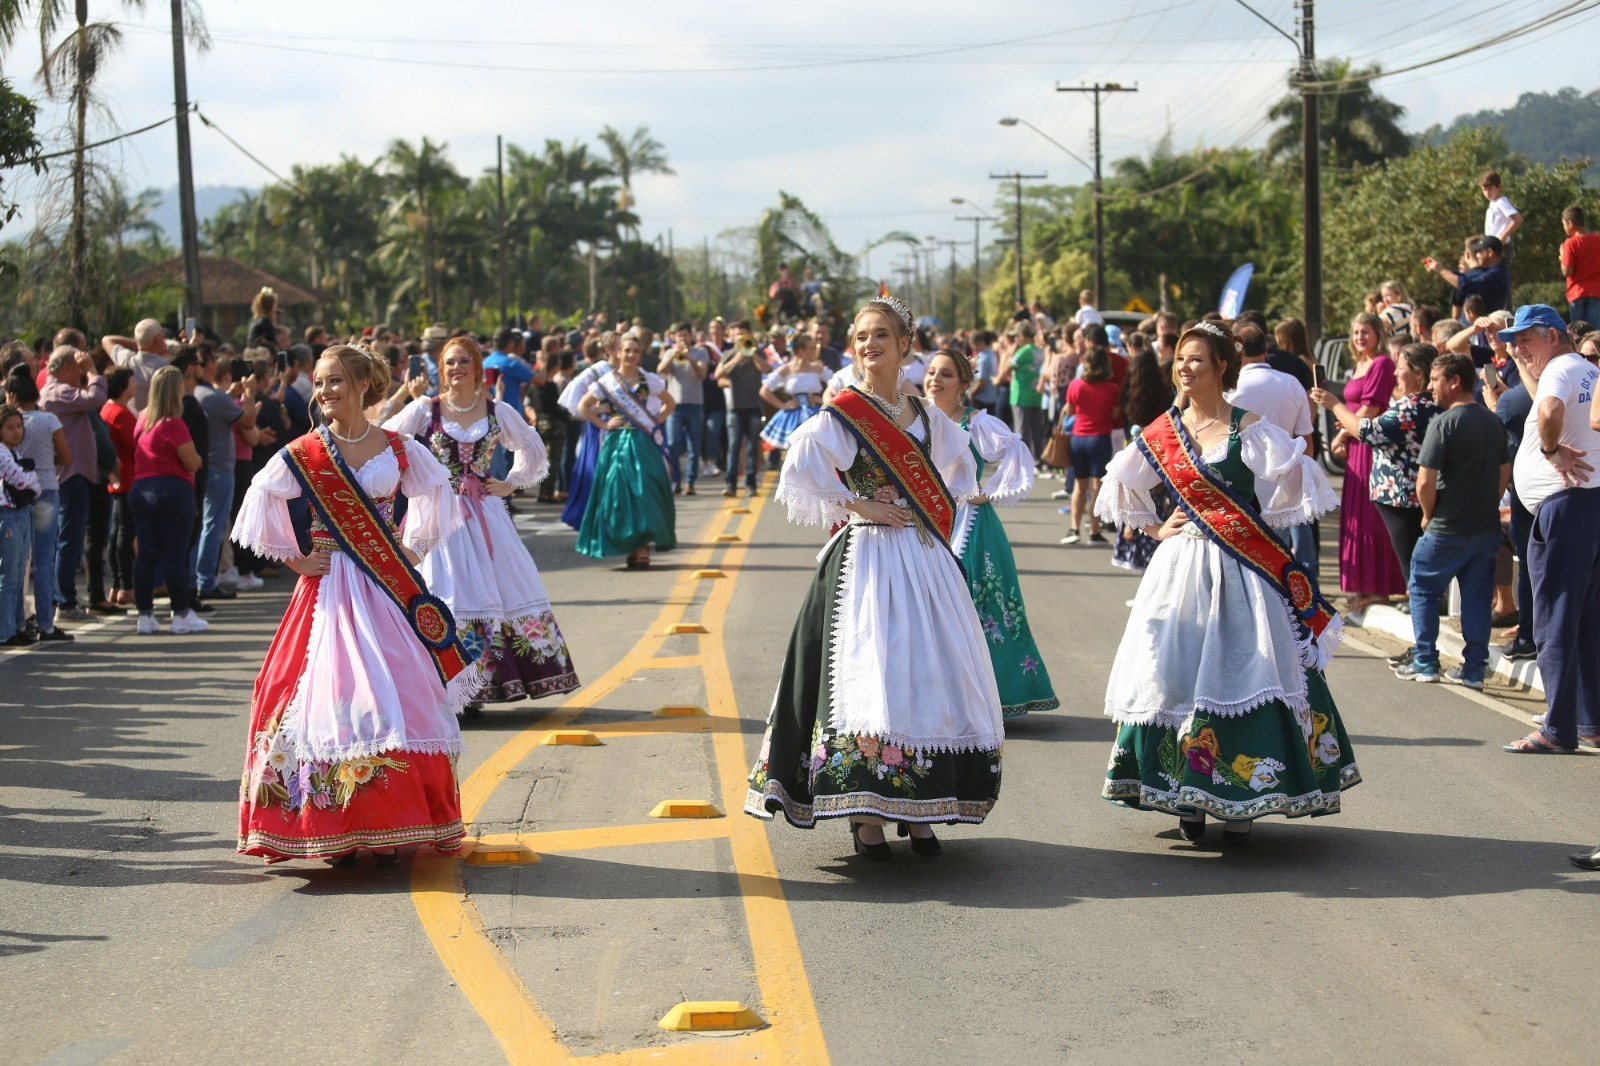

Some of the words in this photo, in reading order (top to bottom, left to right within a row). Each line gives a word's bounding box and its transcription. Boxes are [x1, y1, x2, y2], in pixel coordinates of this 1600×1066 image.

[1581, 377, 1591, 390] OS
[856, 416, 880, 441] Festa
[903, 451, 943, 512] Rainha
[333, 489, 389, 563] Princesa
[1189, 479, 1252, 539] Princesa
[382, 573, 407, 600] Prata
